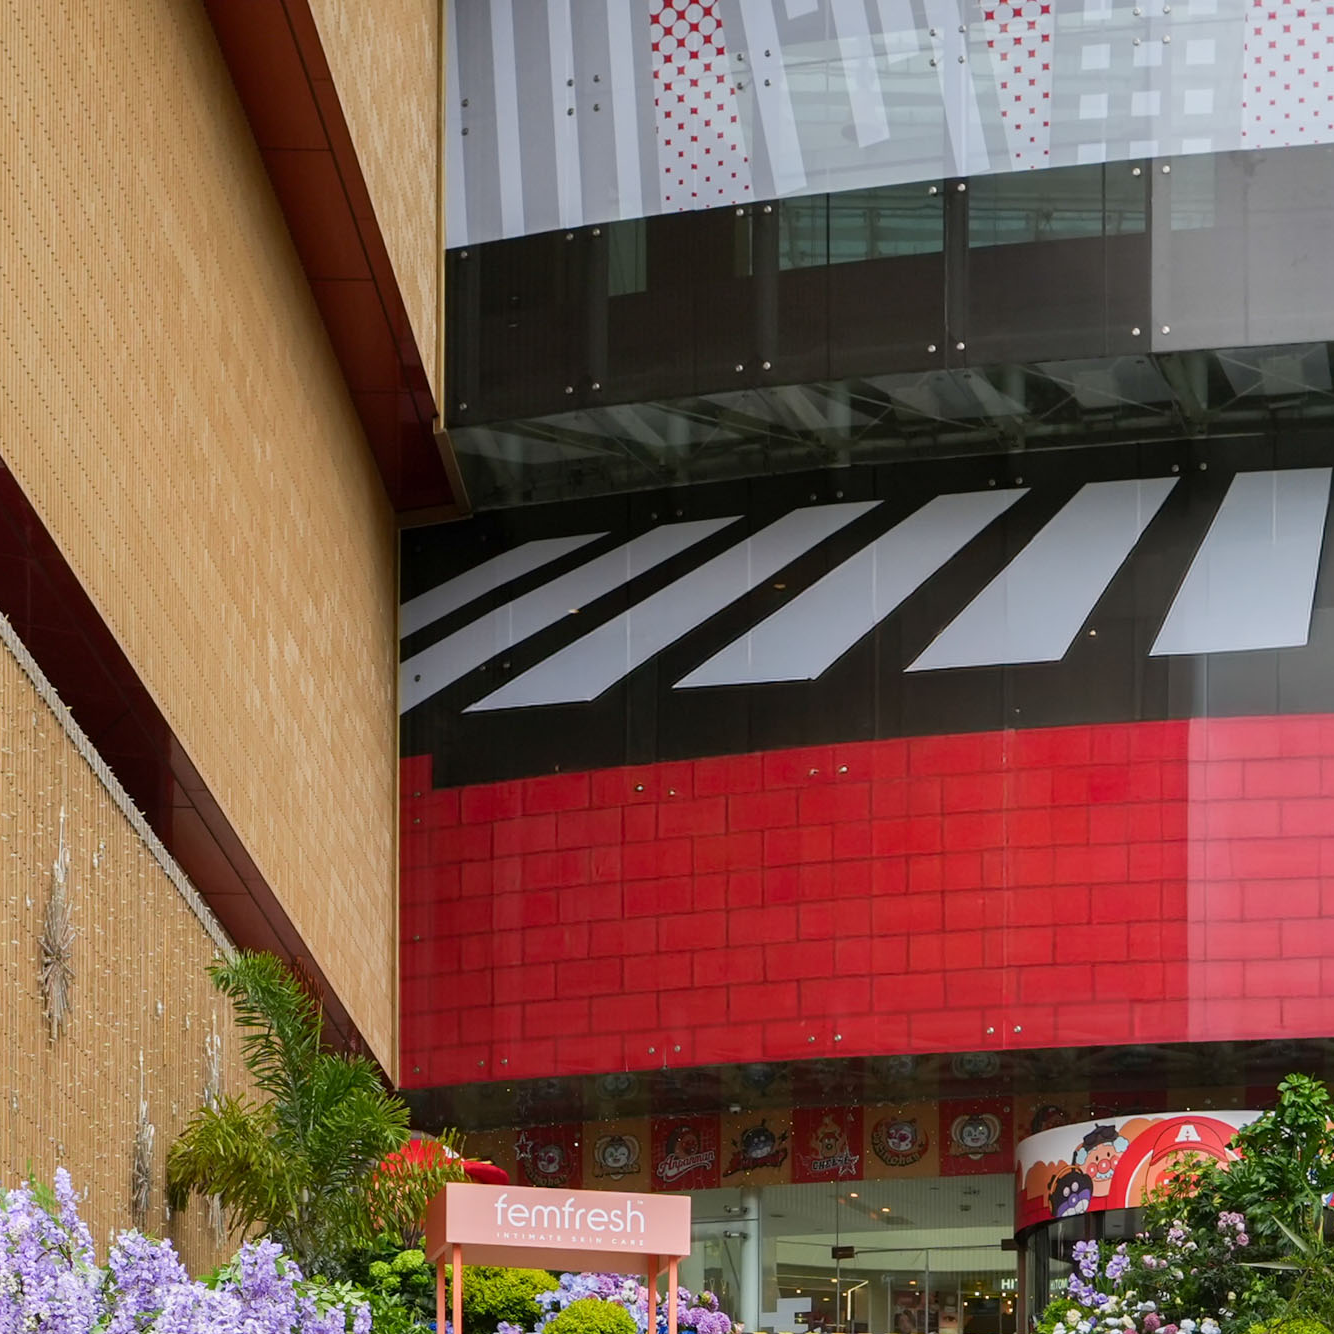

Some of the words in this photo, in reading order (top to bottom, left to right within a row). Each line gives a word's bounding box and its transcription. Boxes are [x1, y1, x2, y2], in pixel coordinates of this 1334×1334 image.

[494, 1193, 645, 1234] femfresh
[496, 1232, 563, 1242] INTIMATE
[571, 1235, 603, 1244] SKIN
[611, 1238, 645, 1247] CARE
